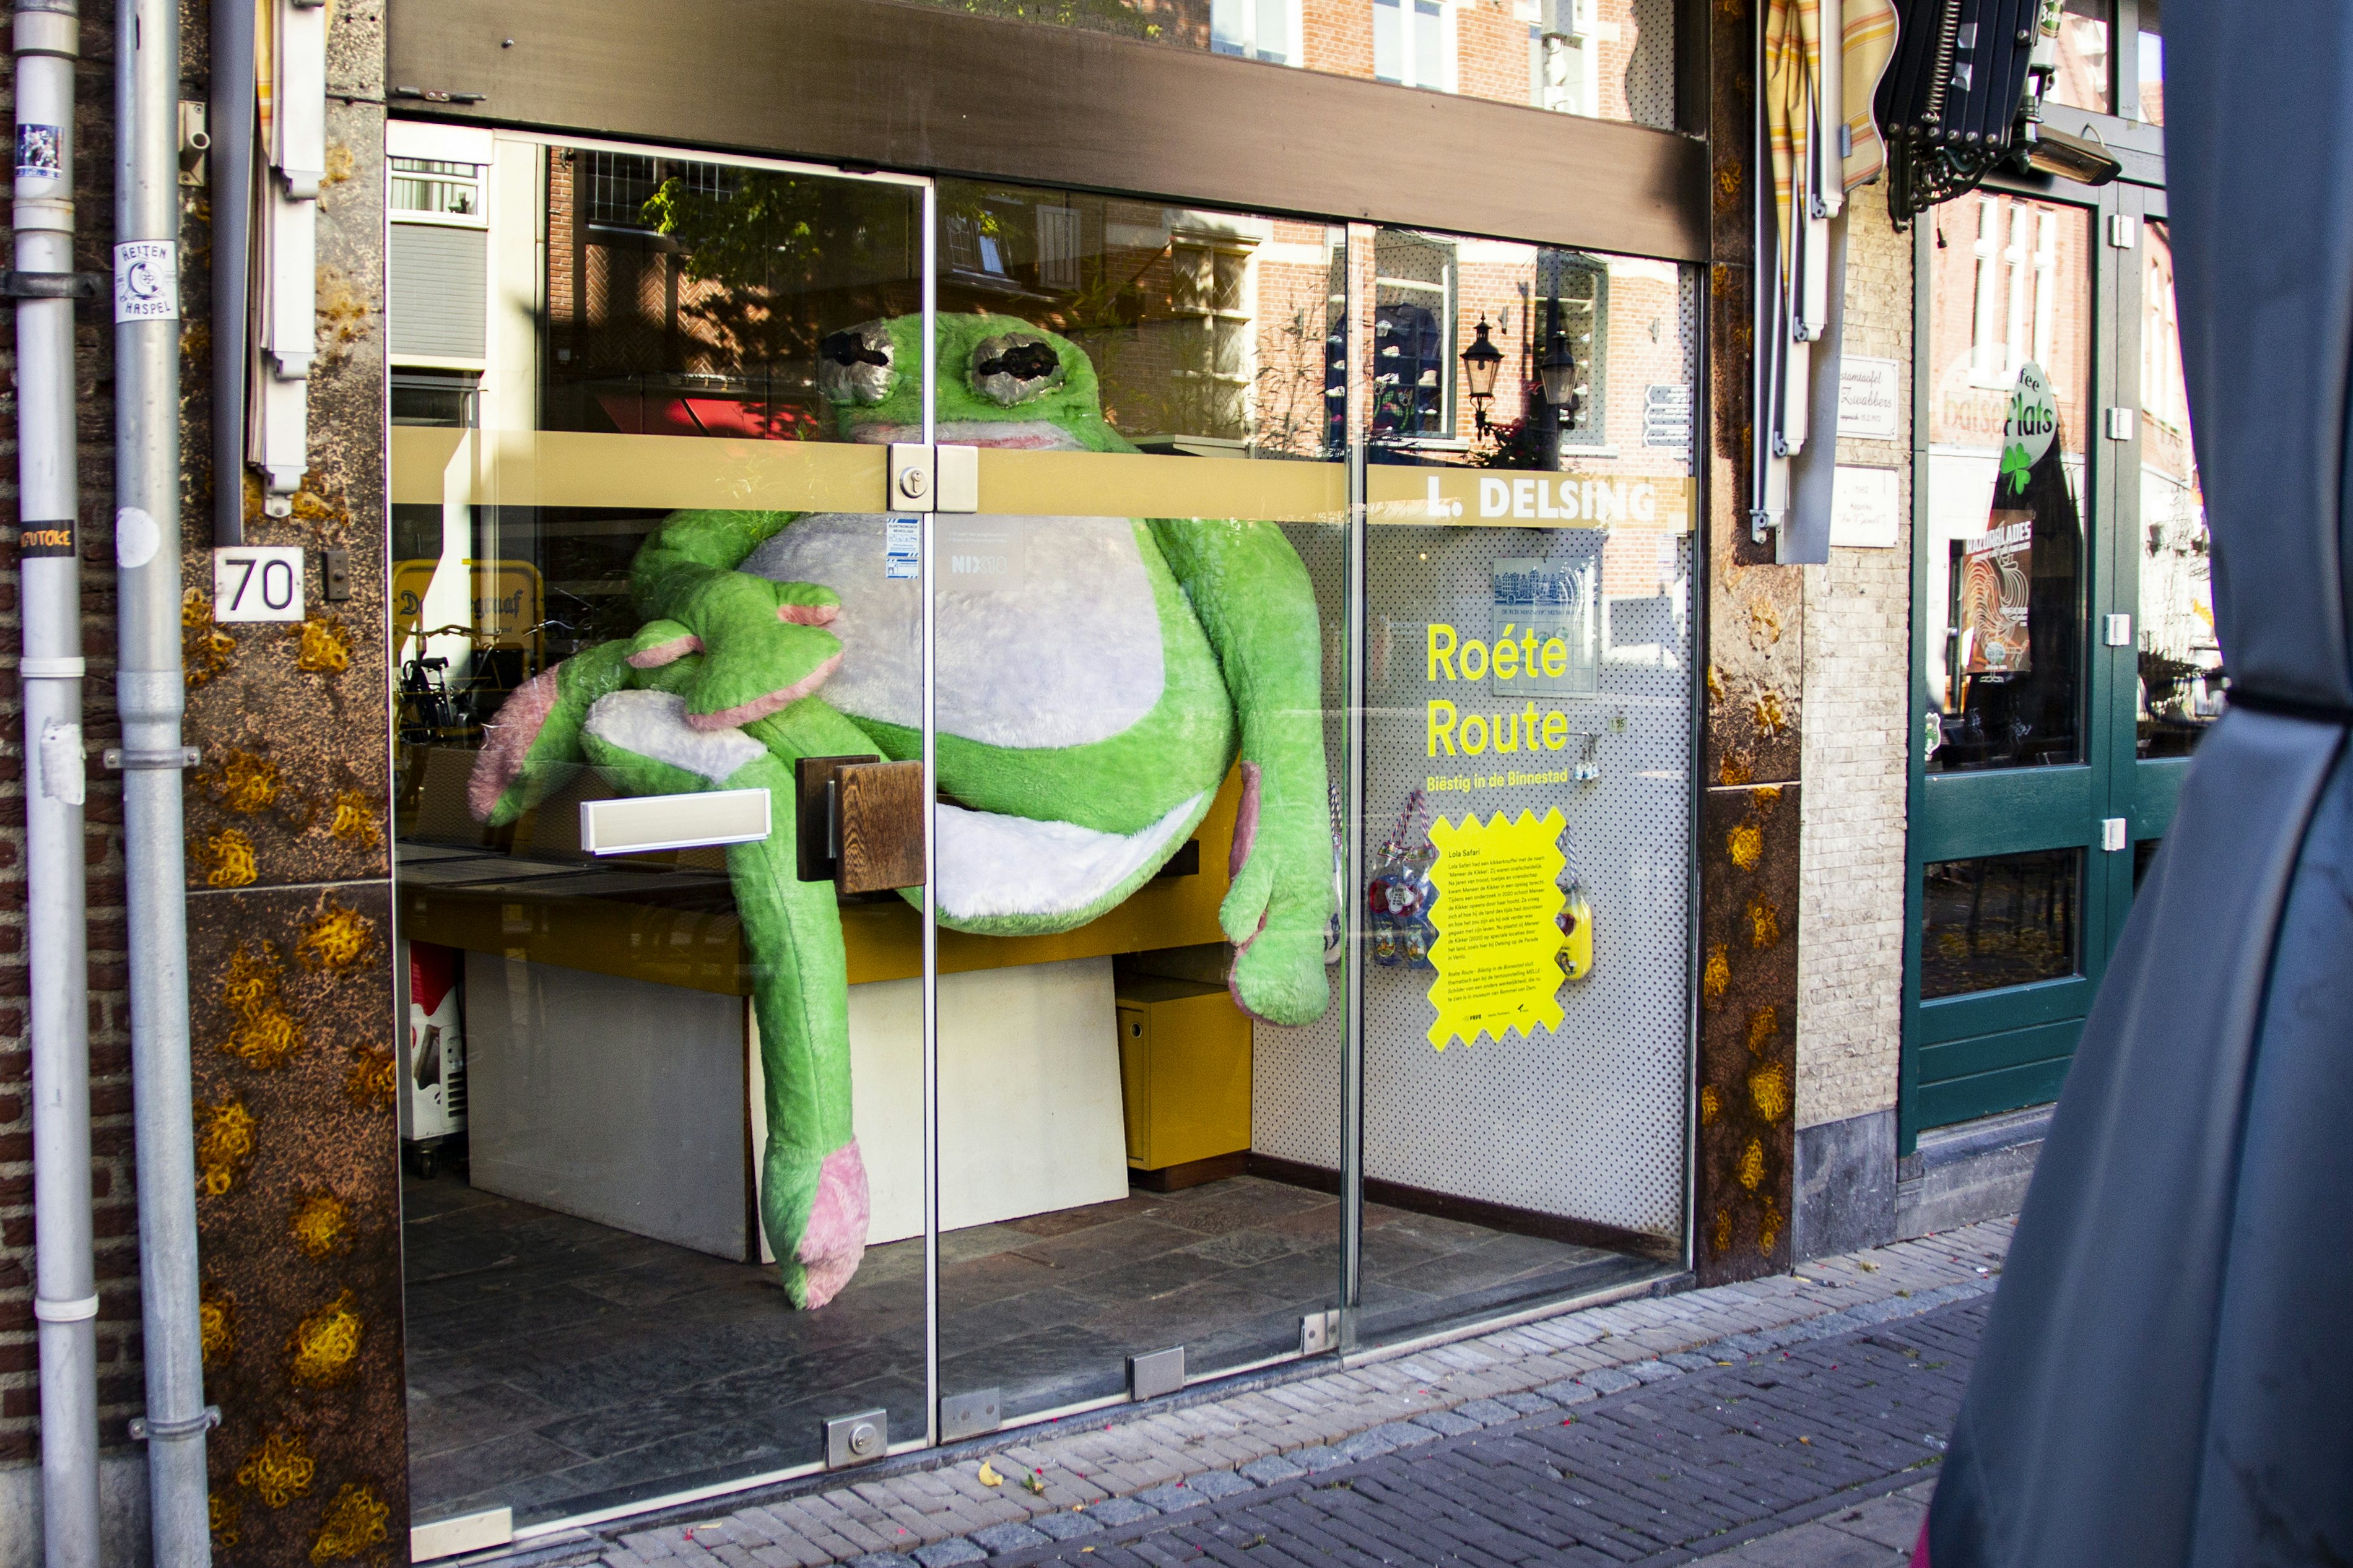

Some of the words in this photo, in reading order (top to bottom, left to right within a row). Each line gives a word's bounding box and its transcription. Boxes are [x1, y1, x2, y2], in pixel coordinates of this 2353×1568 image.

[126, 301, 170, 314] HASPEL
[1841, 387, 1892, 408] Zwabbers
[1428, 476, 1463, 517] L.
[1481, 477, 1655, 521] DELSING
[225, 559, 292, 610] 70
[1428, 624, 1567, 681] Roéte
[1428, 700, 1568, 756] Route
[1427, 774, 1471, 793] Biëstig
[1474, 773, 1485, 789] in
[1489, 772, 1505, 787] de
[1508, 767, 1568, 786] Binnestad
[1462, 848, 1480, 856] Safari
